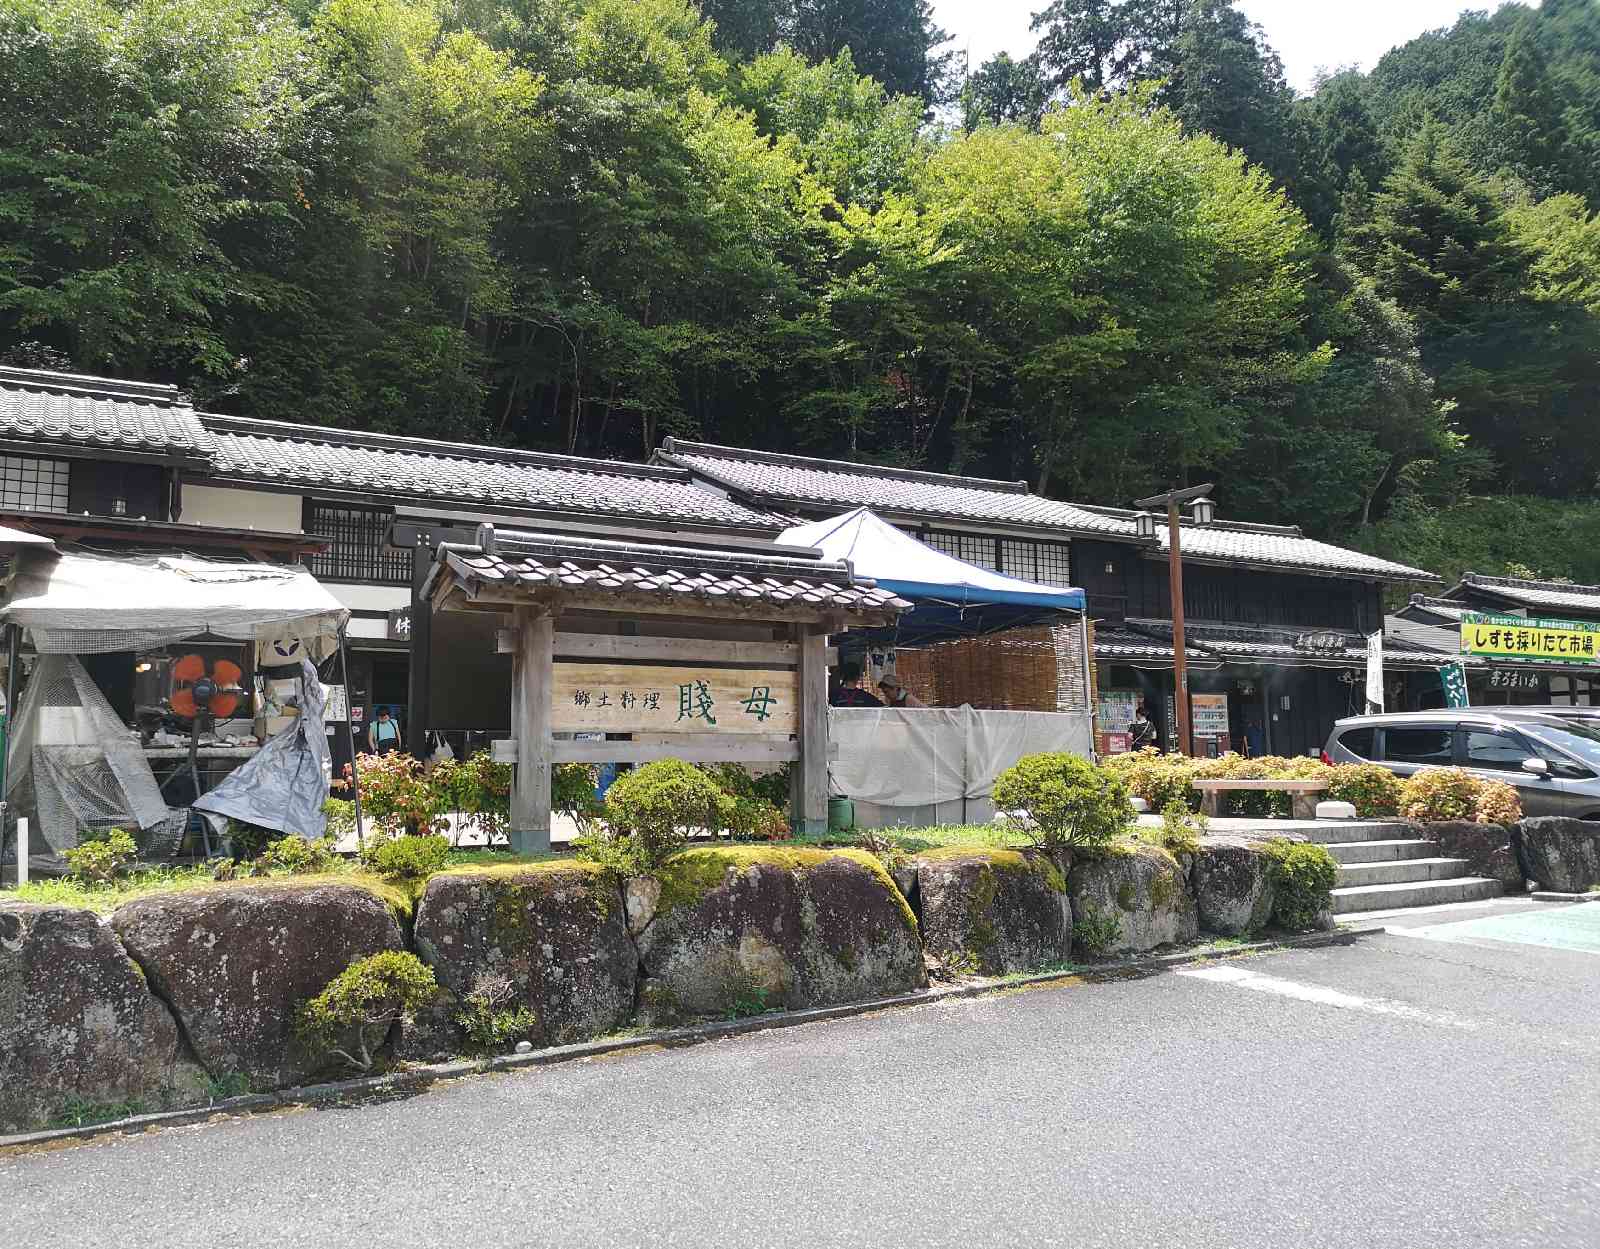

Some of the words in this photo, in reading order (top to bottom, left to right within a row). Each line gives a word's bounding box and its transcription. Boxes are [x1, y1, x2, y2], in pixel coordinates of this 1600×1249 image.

[1475, 629, 1594, 655] しずも採りたて市場
[573, 688, 661, 711] 郷土料理
